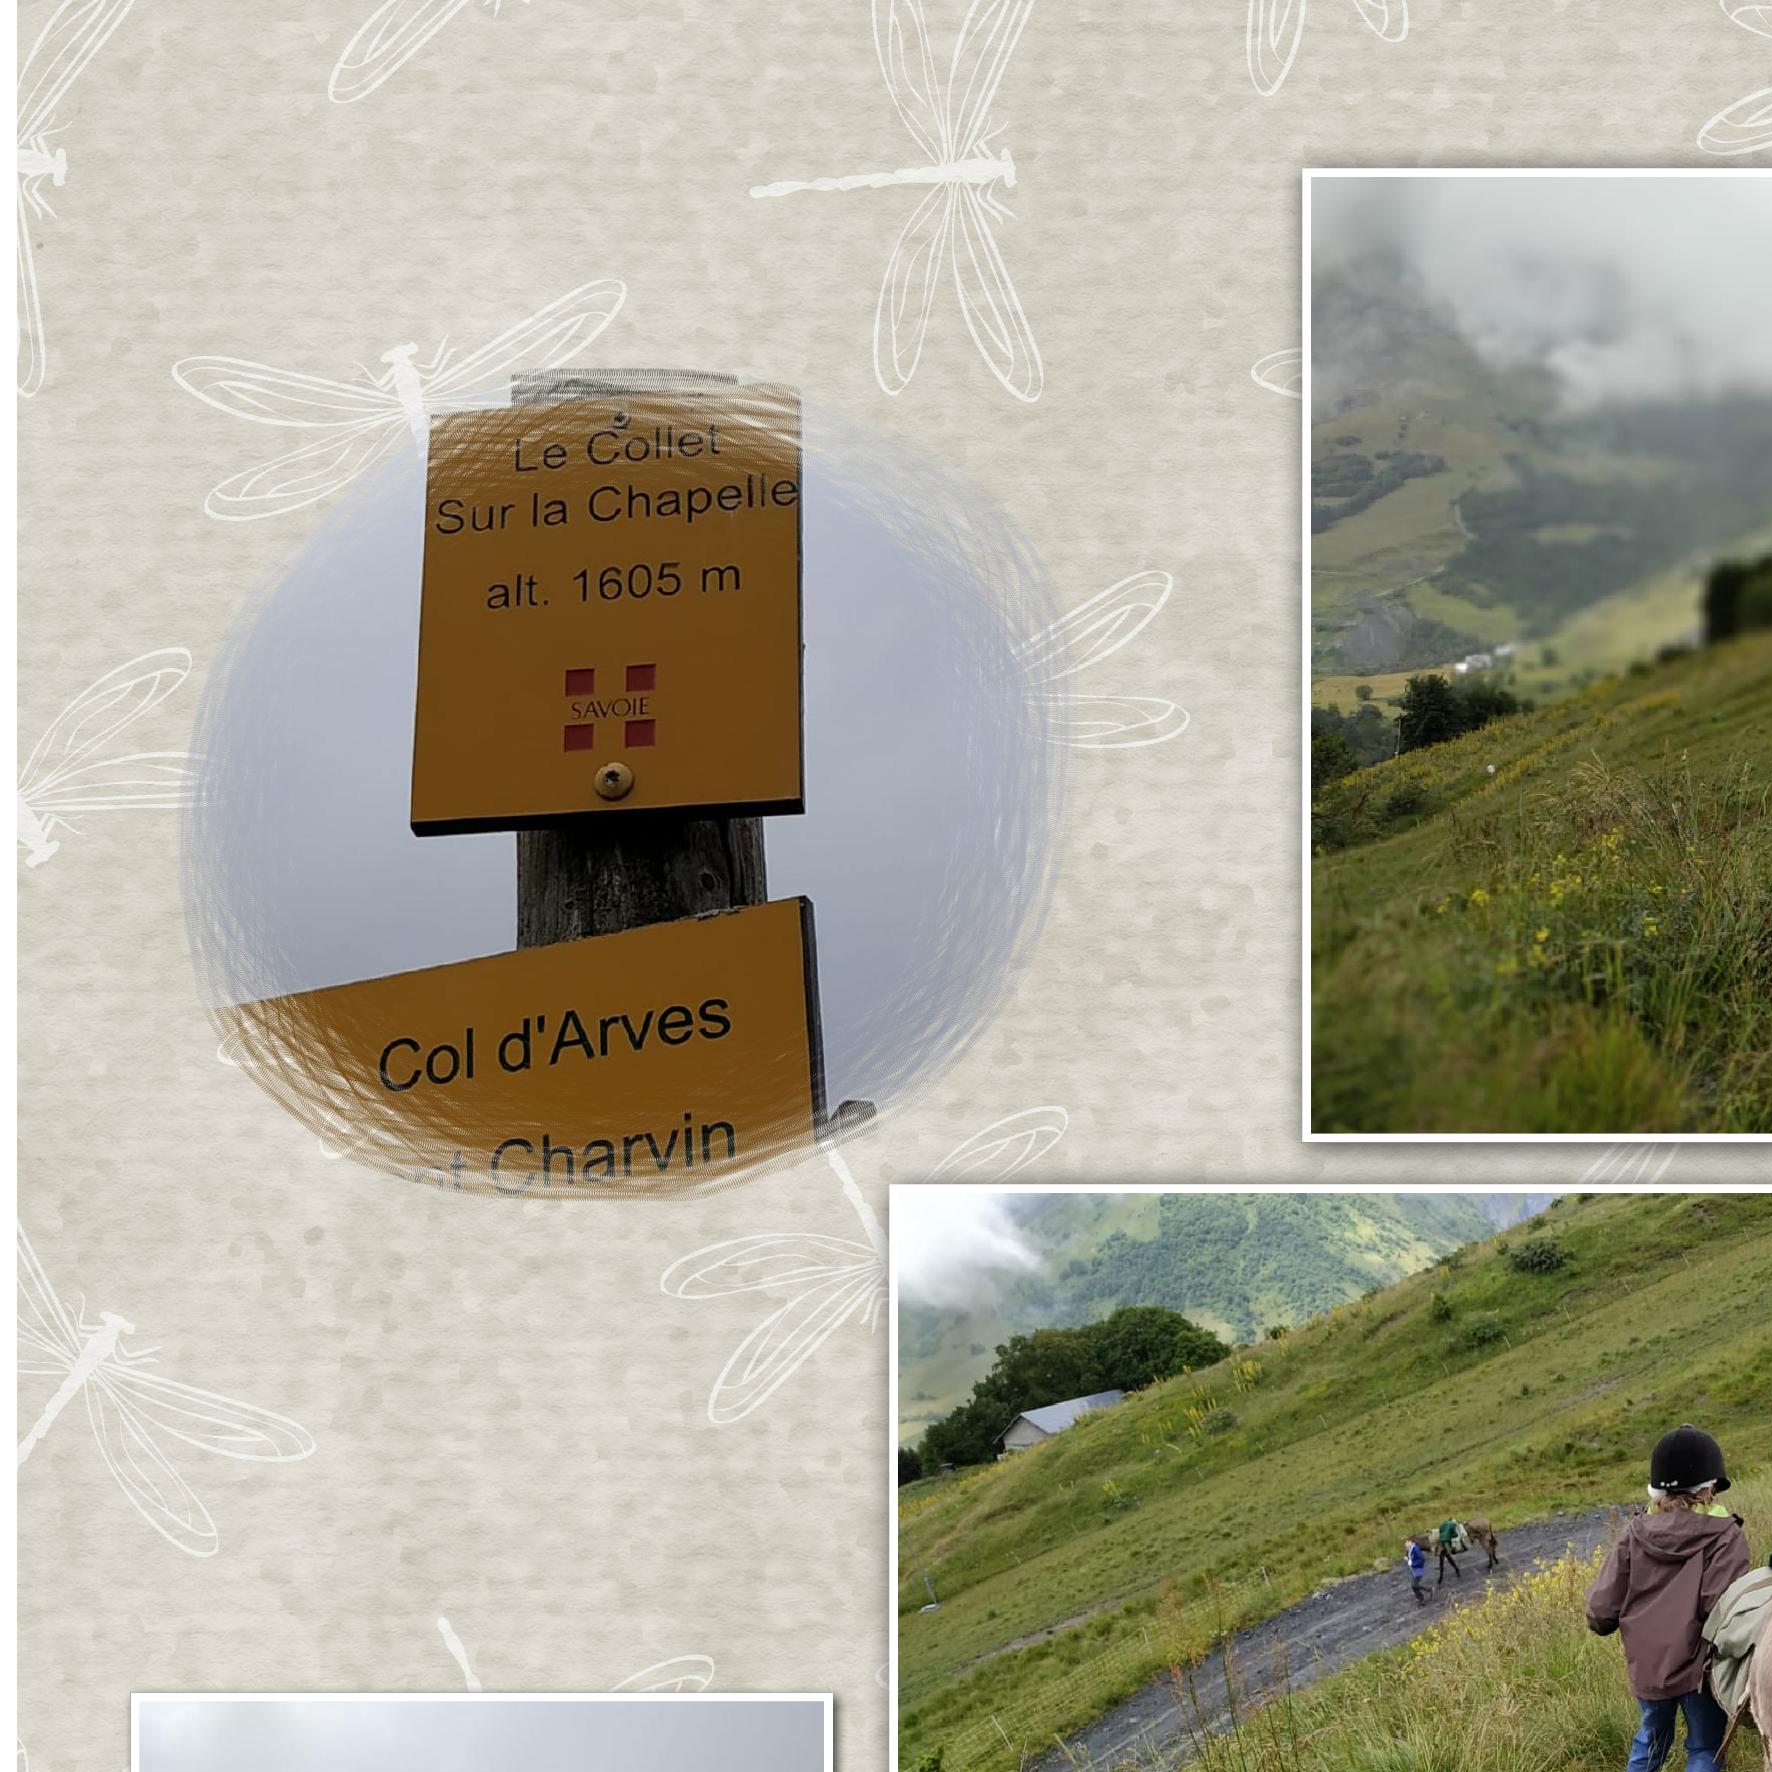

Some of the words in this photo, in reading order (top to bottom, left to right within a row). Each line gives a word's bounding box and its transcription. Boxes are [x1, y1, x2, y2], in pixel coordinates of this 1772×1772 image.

[514, 437, 568, 473] Le
[586, 424, 721, 466] Collet
[435, 498, 515, 535] Sur
[532, 492, 568, 528] la
[588, 472, 799, 524] Chapelle
[486, 573, 549, 610] alt.
[572, 561, 682, 603] 1605
[701, 564, 741, 593] m
[571, 697, 650, 720] SAVOIE
[379, 1027, 474, 1092] Col
[498, 997, 732, 1073] d'Arves
[491, 1112, 737, 1194] Charvin
